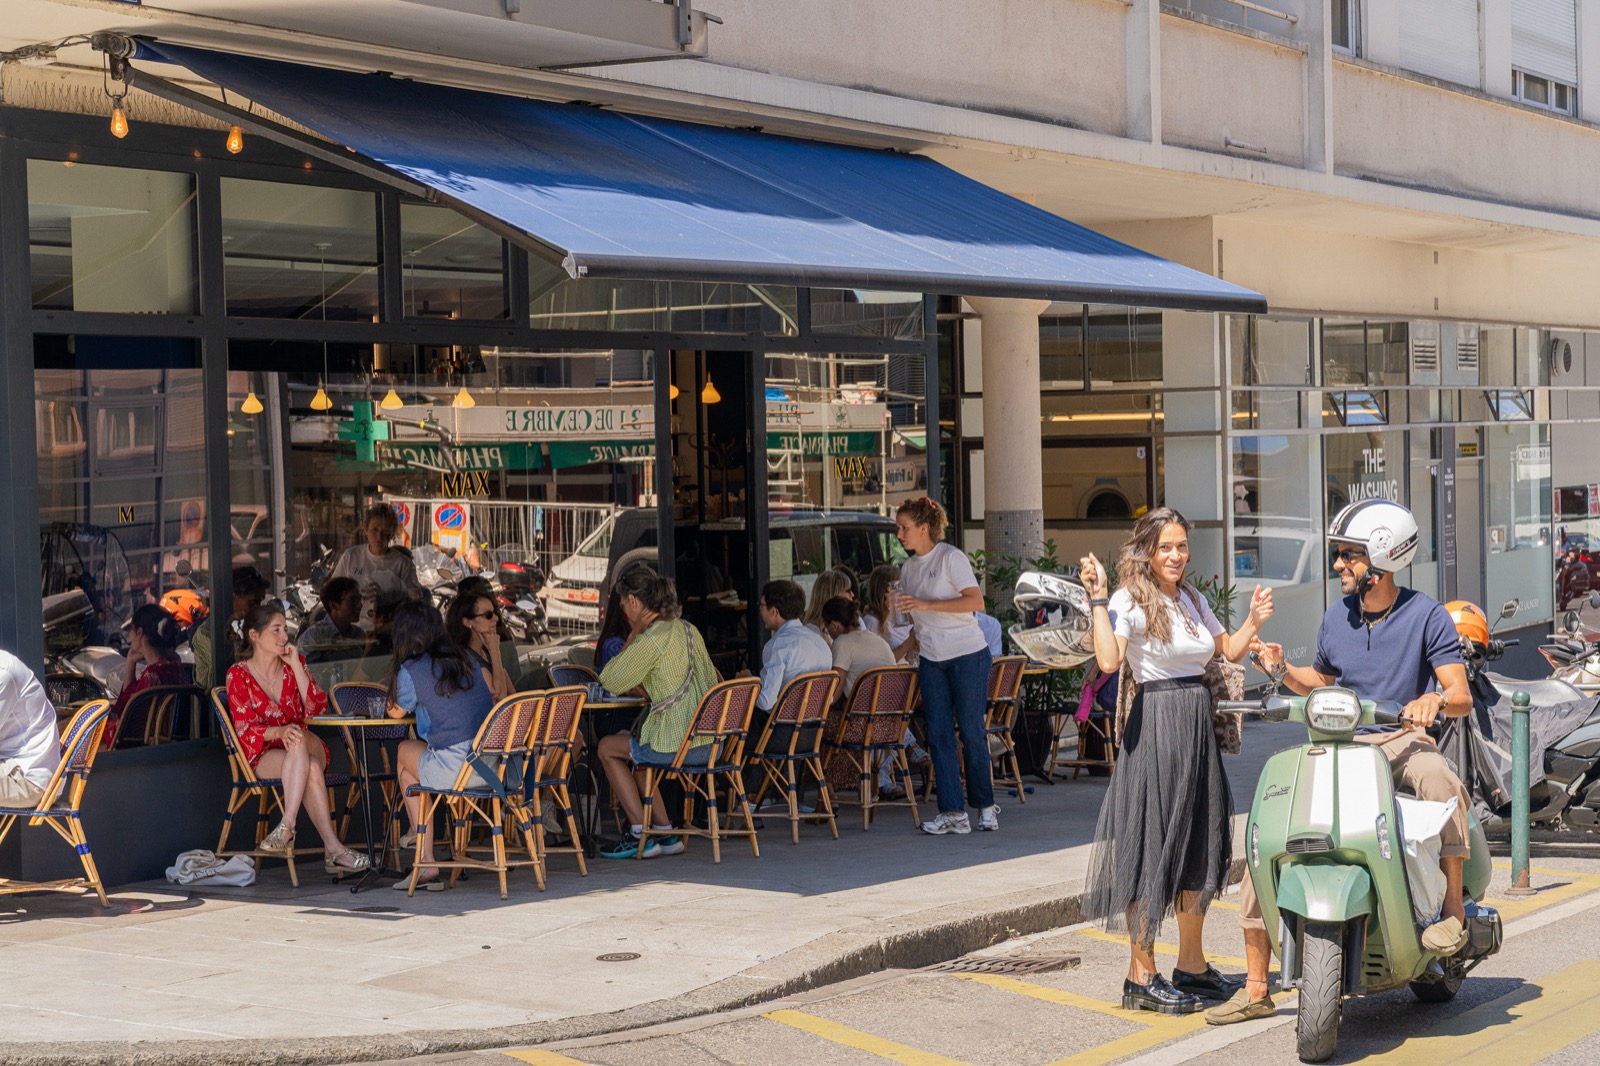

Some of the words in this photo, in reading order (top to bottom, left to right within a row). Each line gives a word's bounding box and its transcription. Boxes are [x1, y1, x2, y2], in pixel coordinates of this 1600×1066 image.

[834, 455, 868, 479] MAX
[1362, 447, 1384, 475] THE
[441, 470, 490, 498] MAX
[1348, 479, 1398, 504] WASHING
[118, 505, 135, 523] M
